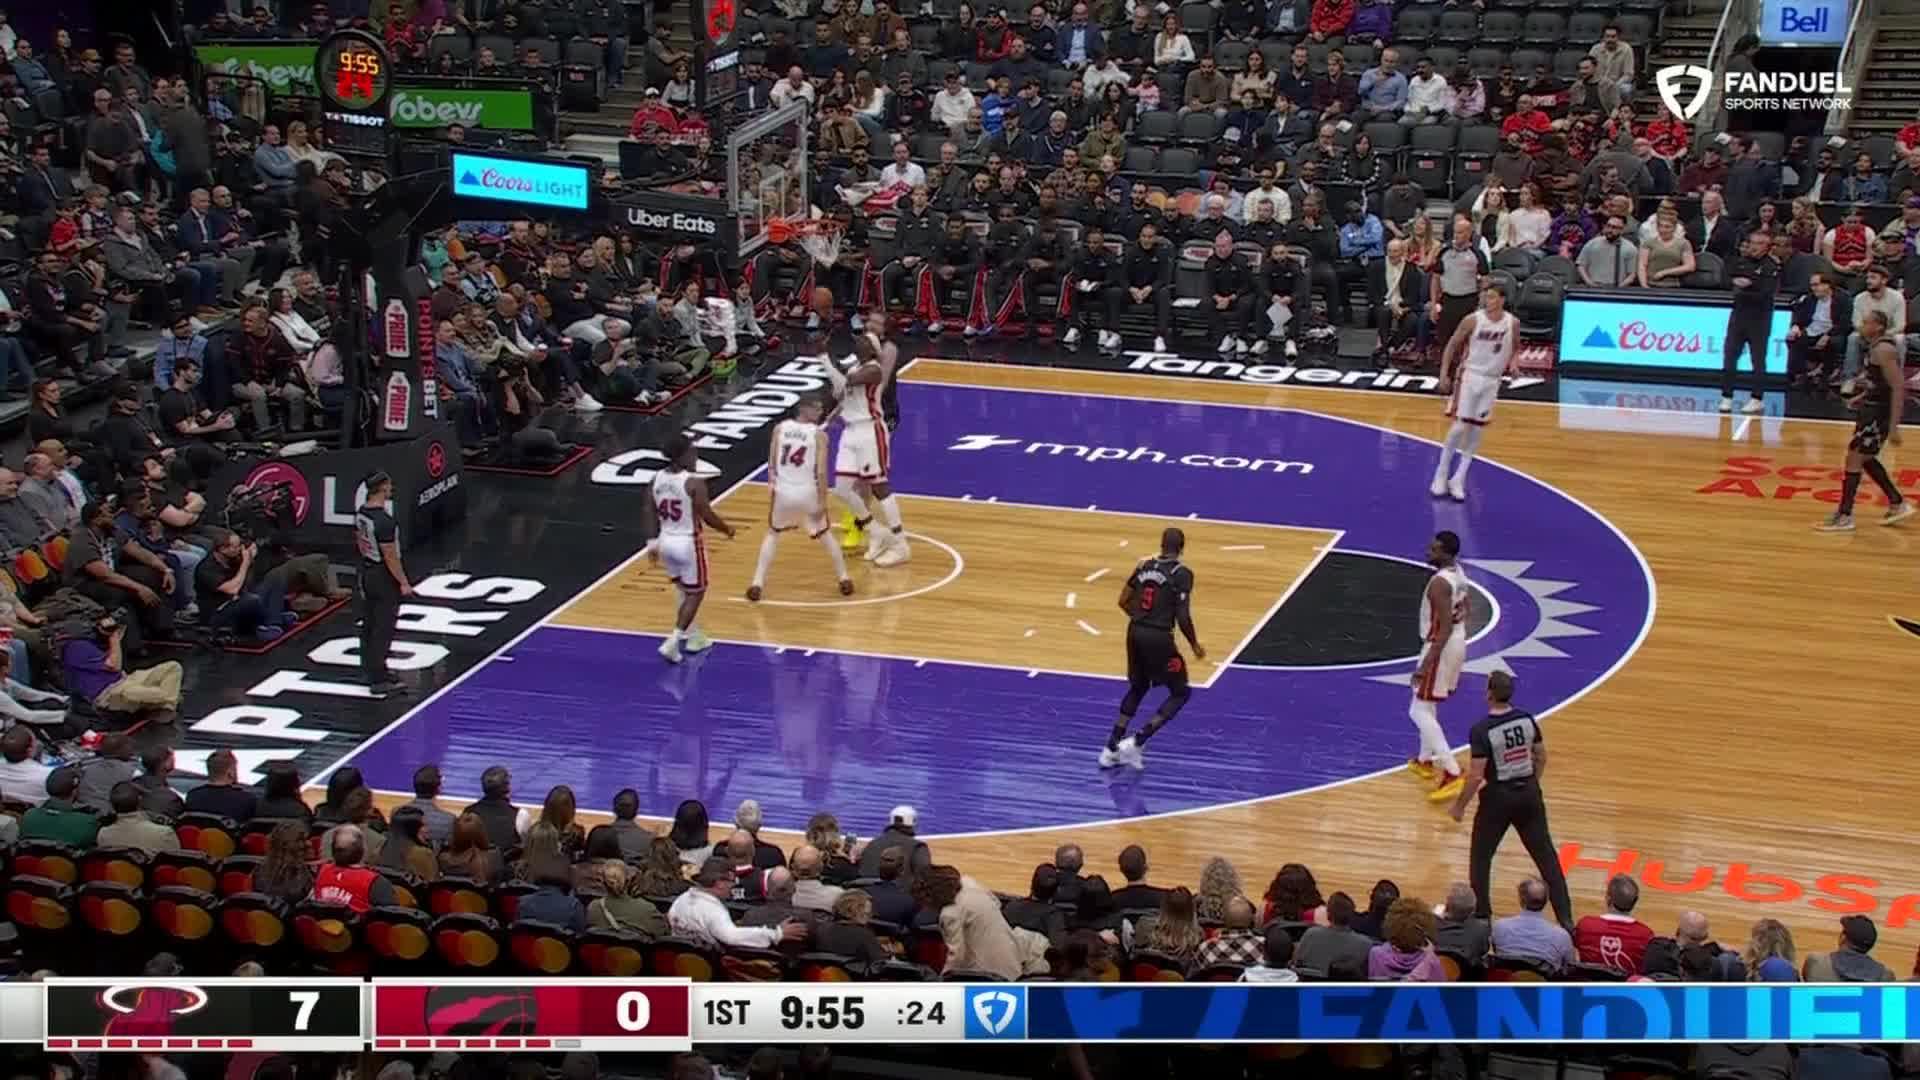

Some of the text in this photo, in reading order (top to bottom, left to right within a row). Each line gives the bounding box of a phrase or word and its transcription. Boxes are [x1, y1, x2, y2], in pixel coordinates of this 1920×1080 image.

[1780, 7, 1828, 32] Bell
[340, 52, 379, 75] 9:55
[341, 113, 384, 126] TISSOT
[481, 167, 584, 199] Coors LIGHT
[628, 207, 716, 234] Uber Eats
[1619, 321, 1702, 352] Coors
[1123, 351, 1440, 391] Tangerin
[681, 353, 858, 449] FANDUE
[780, 443, 807, 467] 14
[1025, 441, 1314, 474] mph.com
[657, 498, 683, 522] 45
[1502, 725, 1526, 750] 58
